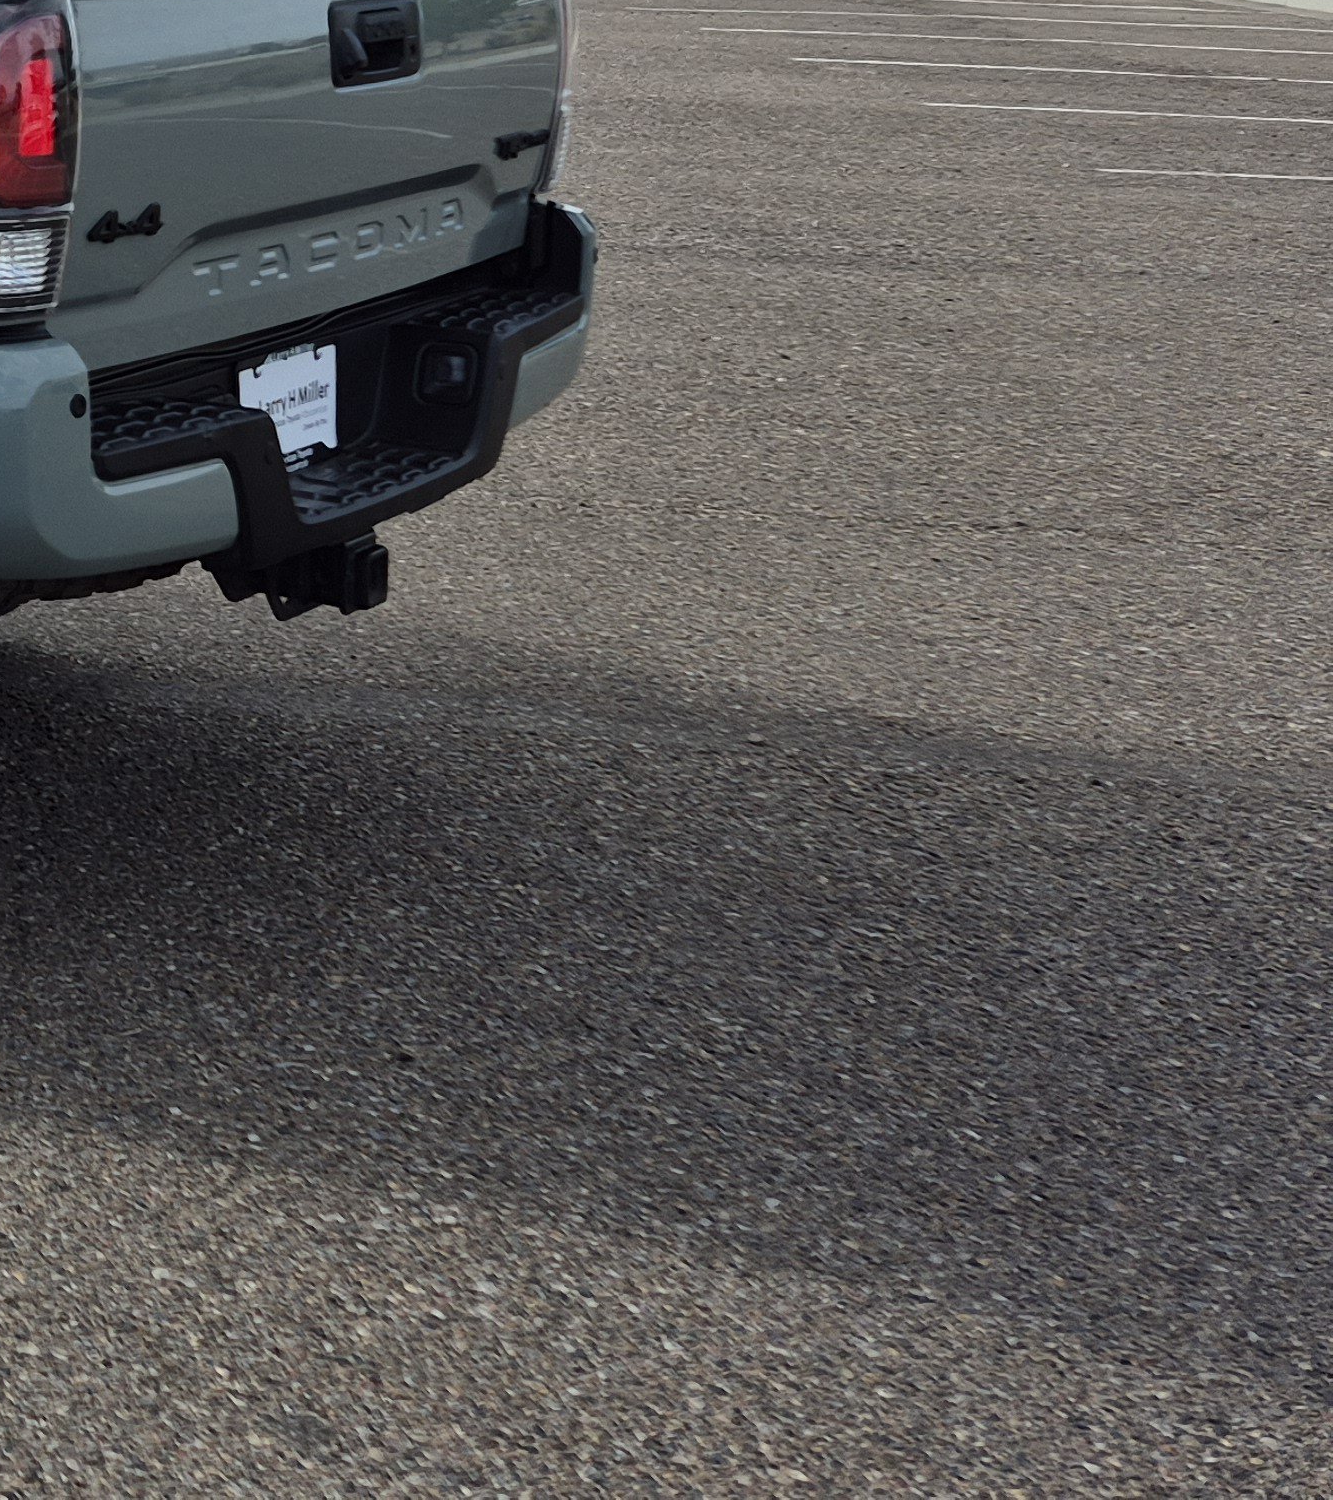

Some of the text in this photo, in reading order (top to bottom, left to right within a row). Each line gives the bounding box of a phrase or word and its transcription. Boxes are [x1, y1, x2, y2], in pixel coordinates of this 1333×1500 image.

[193, 197, 465, 297] TACOMA
[287, 388, 297, 410] H
[298, 379, 330, 406] Miller
